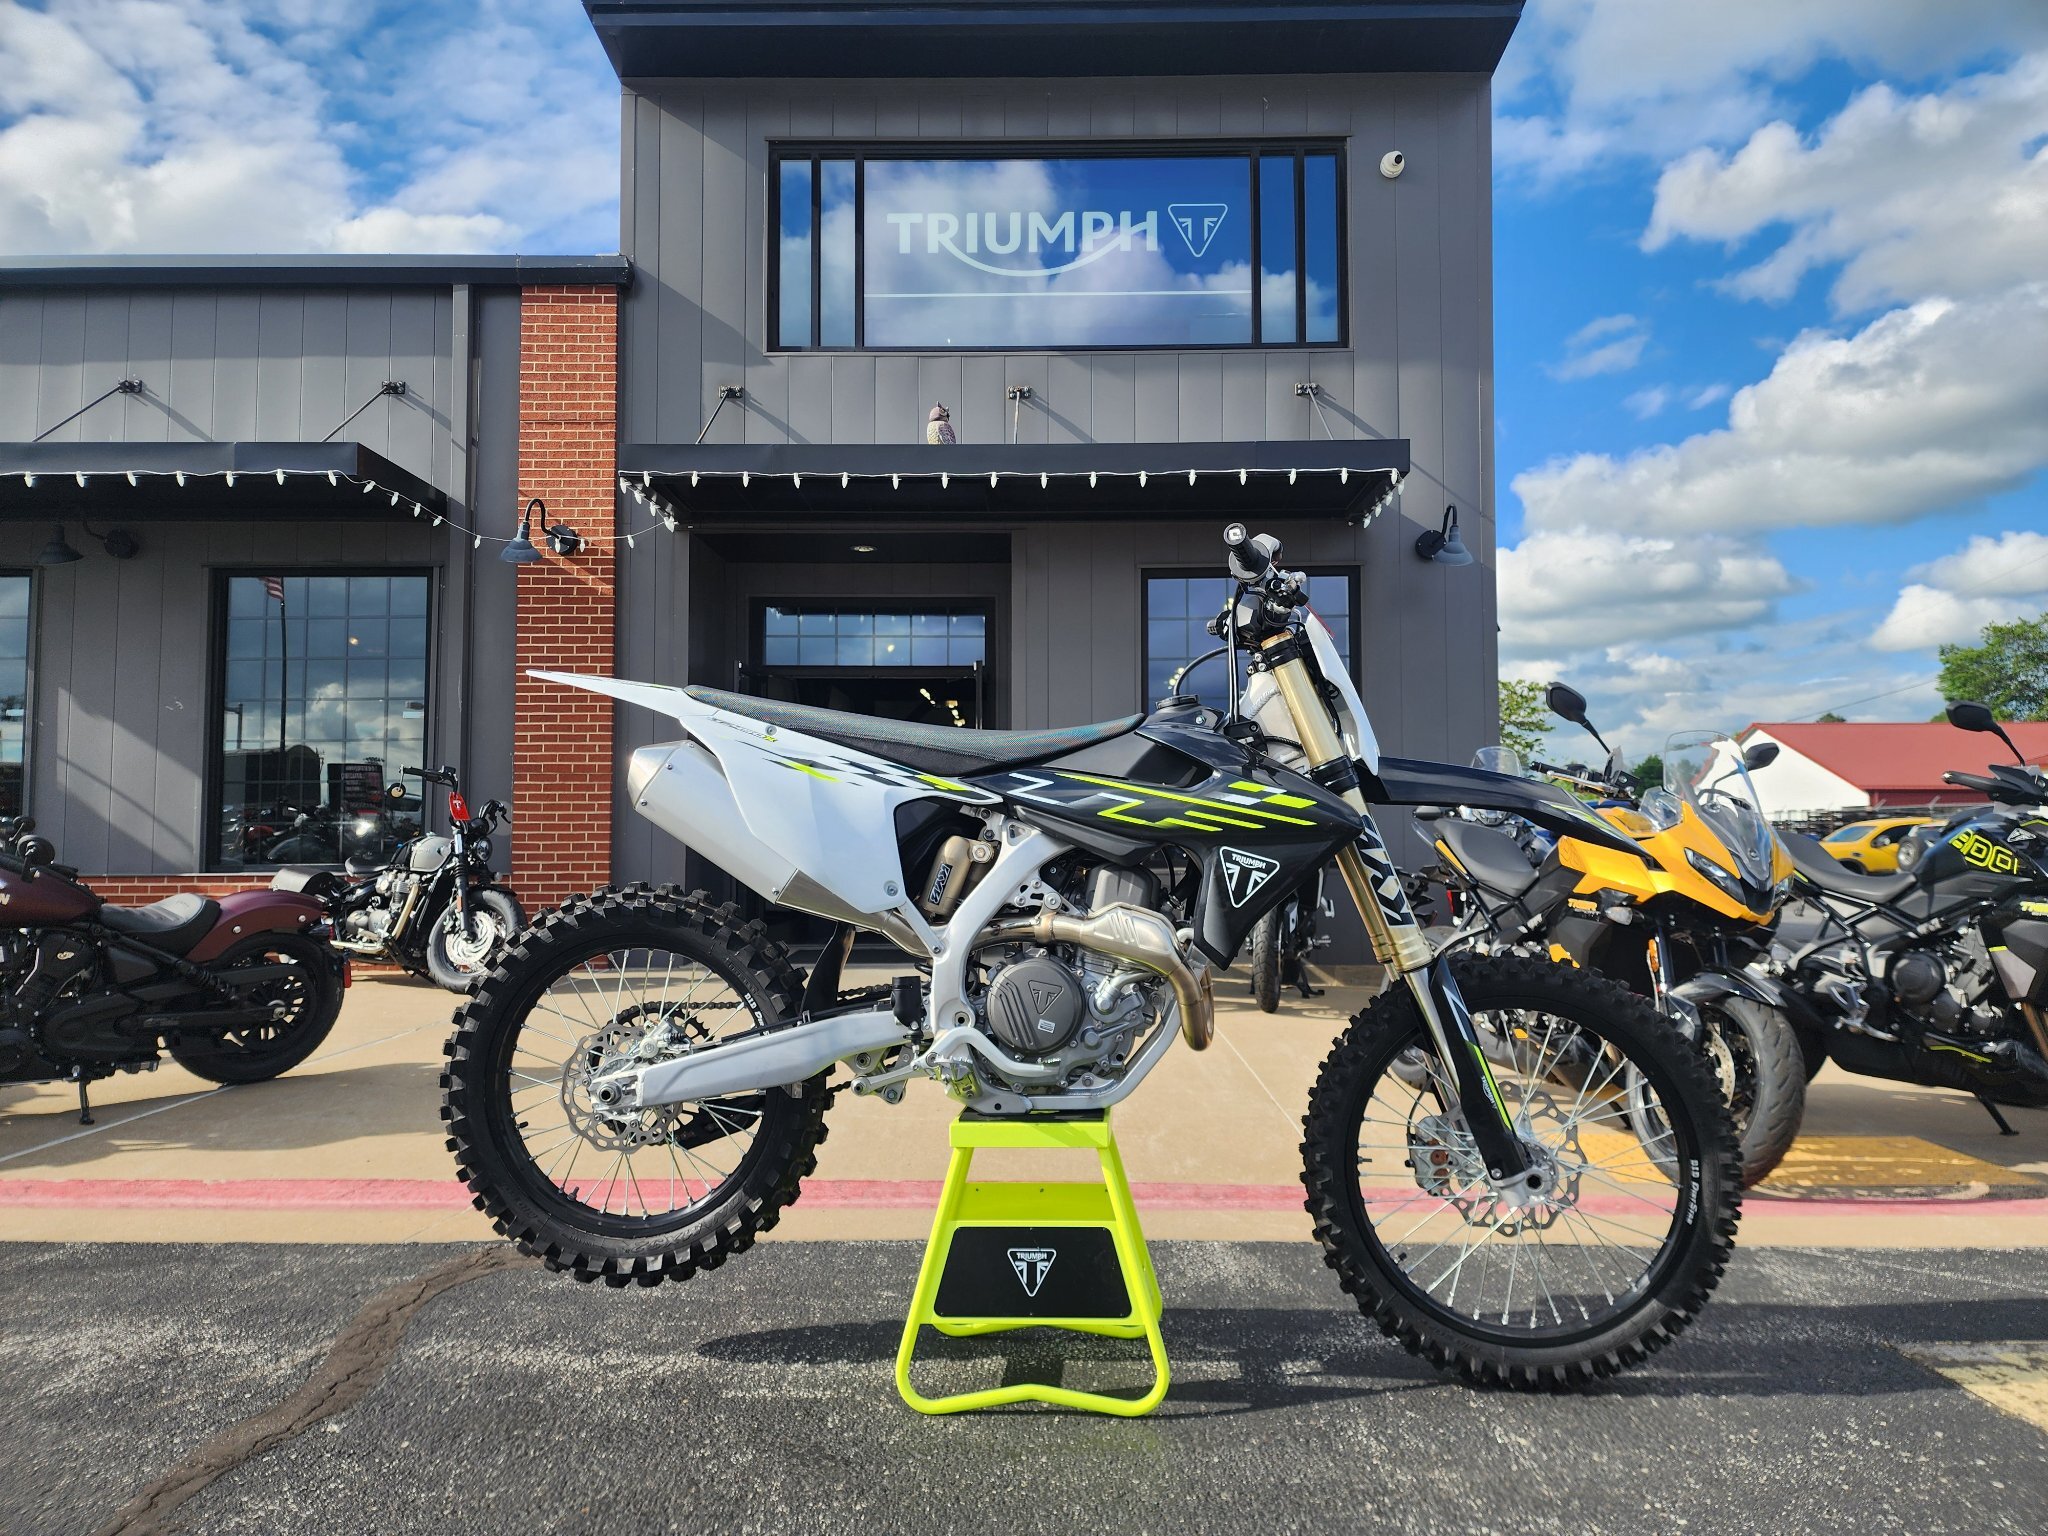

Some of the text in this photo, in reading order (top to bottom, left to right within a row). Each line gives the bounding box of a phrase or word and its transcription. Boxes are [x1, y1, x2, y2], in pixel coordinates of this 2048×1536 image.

[887, 211, 1158, 276] TRIUMPH
[1232, 853, 1267, 870] TRIUMPH
[1481, 1075, 1496, 1104] TRIUMPH
[1016, 1252, 1048, 1263] TRIUMPH
